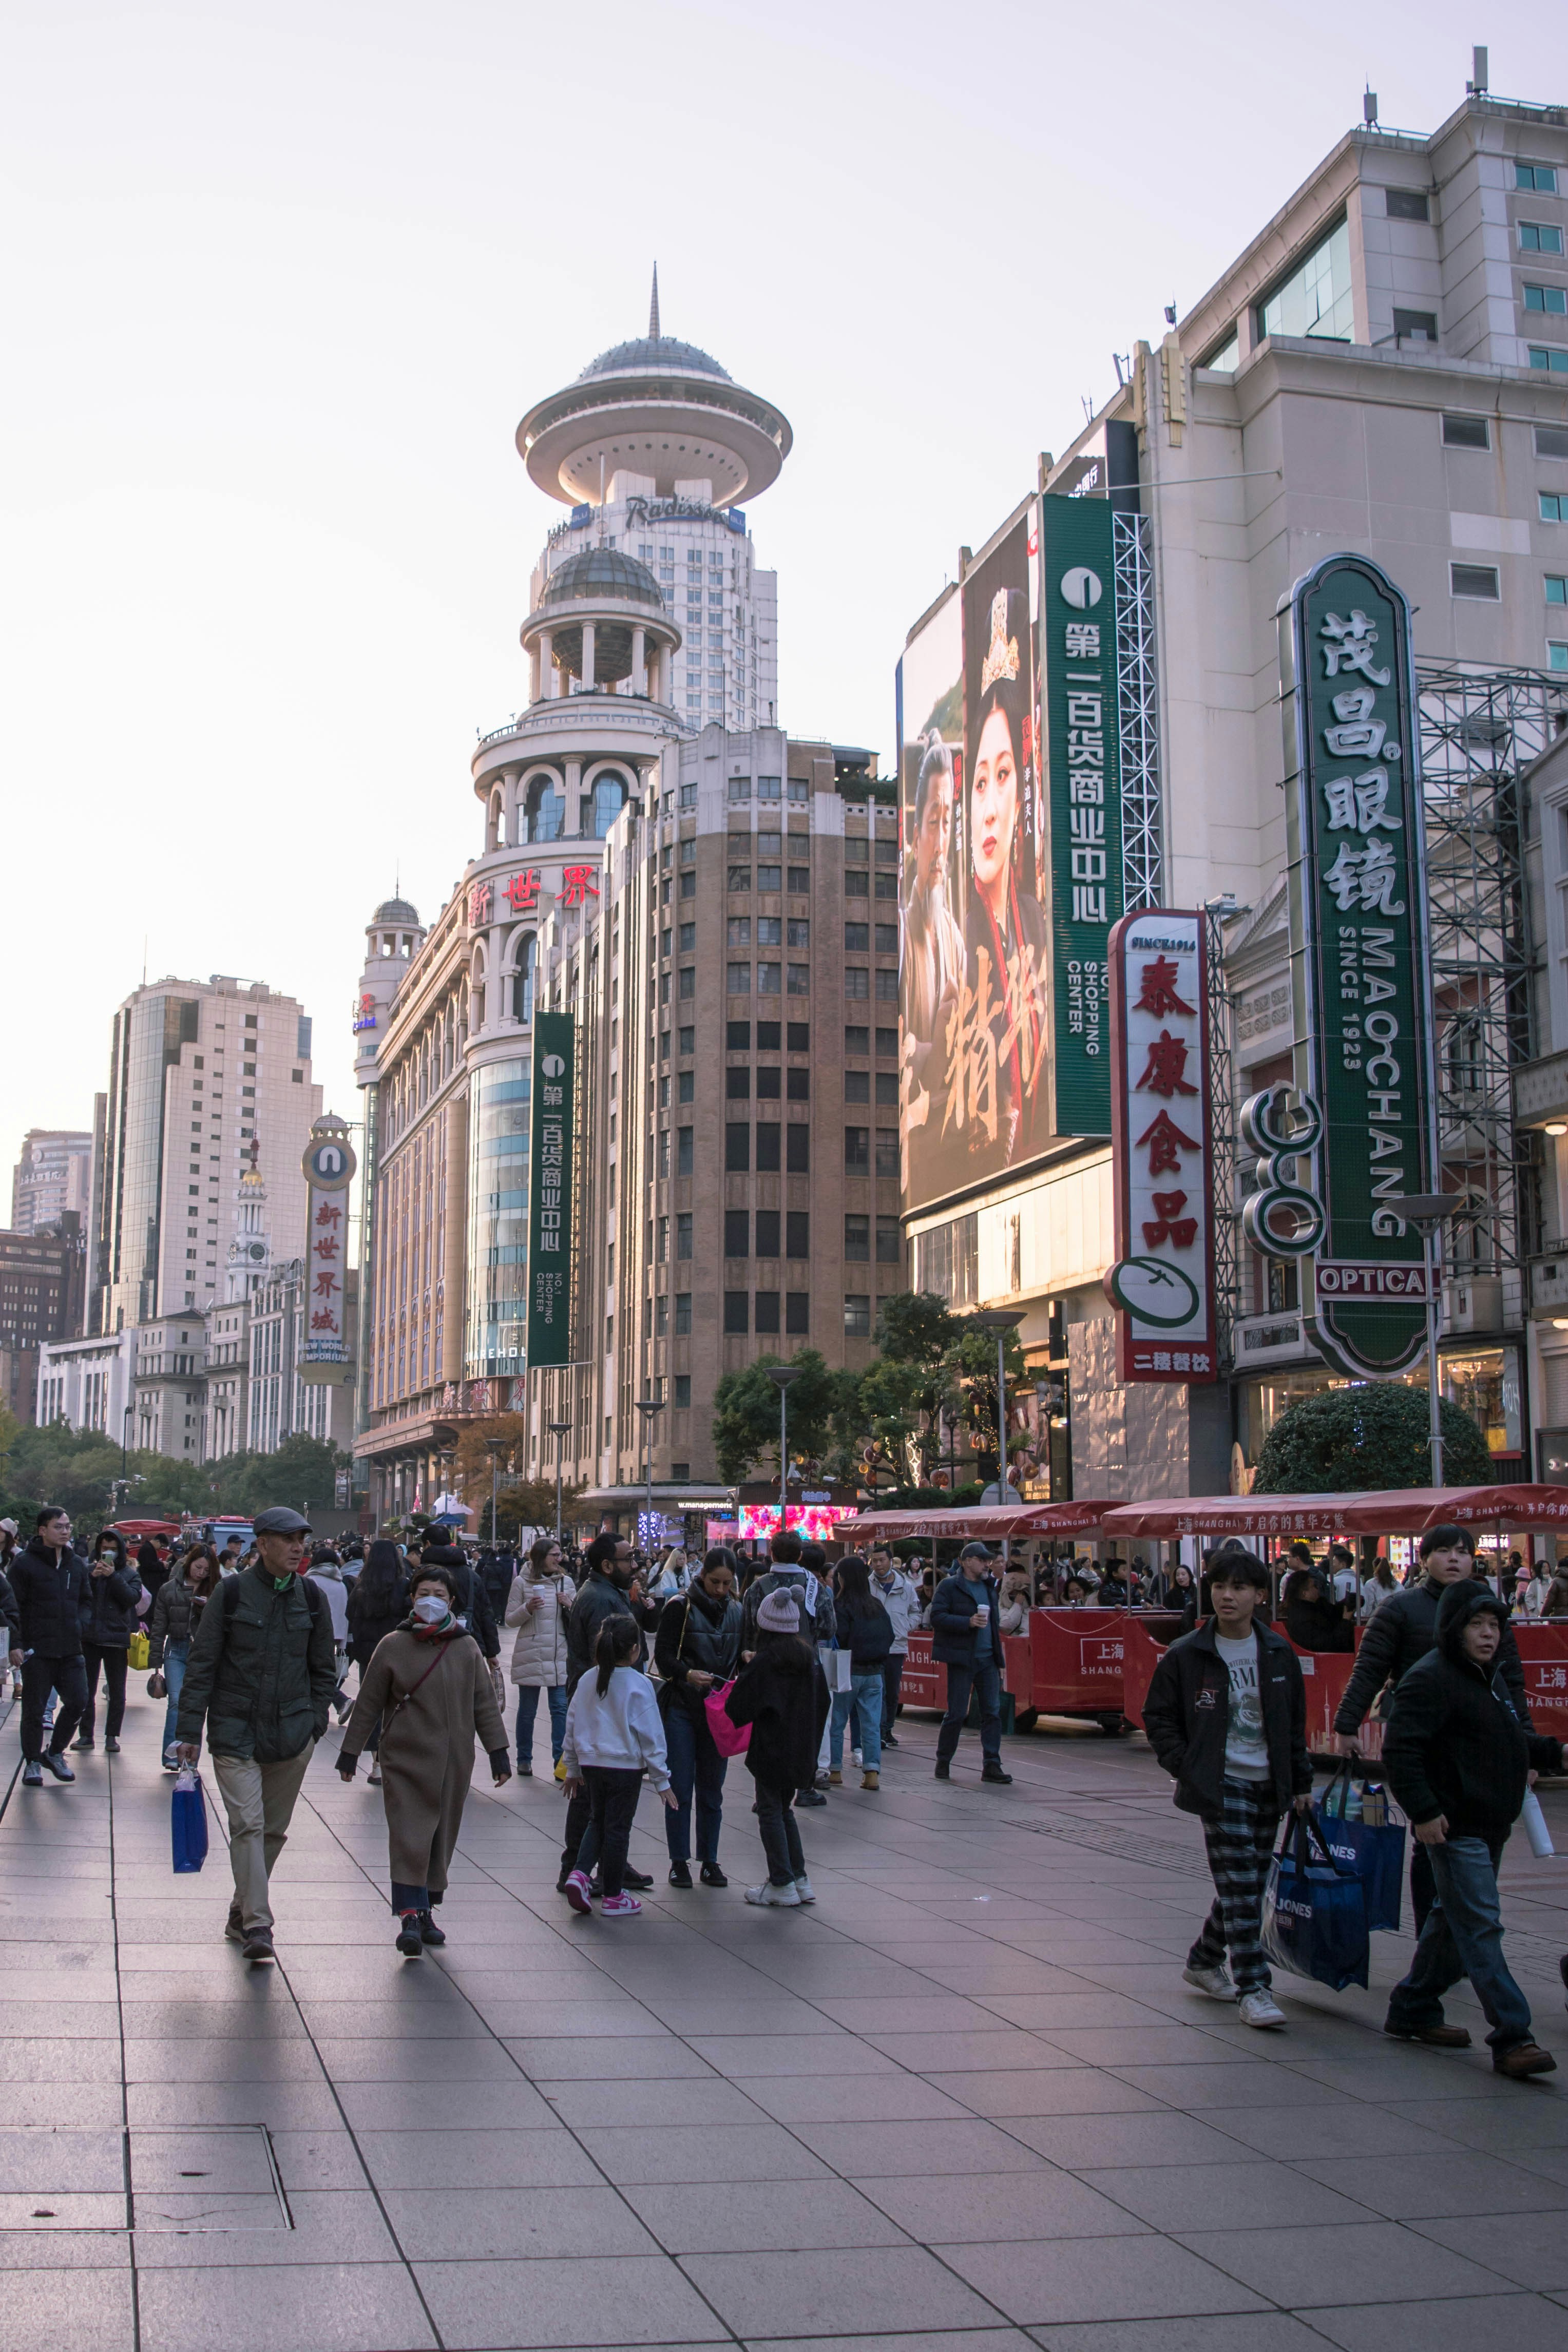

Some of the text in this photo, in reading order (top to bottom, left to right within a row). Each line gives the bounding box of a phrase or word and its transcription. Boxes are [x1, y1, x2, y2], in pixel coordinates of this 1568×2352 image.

[730, 514, 744, 526] BLU
[1065, 623, 1107, 923] 第一百货商业中心
[1320, 609, 1405, 915] 茂昌眼镜
[468, 866, 600, 925] 新世界
[1067, 960, 1083, 1034] CENTER
[1084, 961, 1099, 1056] SHOPPING
[1338, 927, 1362, 1070] SINCE 1923
[1361, 928, 1406, 1238] MAOCHANG
[1133, 954, 1201, 1249] 泰康食品
[540, 1086, 563, 1252] 第一百货商业中心
[311, 1201, 341, 1334] 新世界城
[1319, 1269, 1440, 1294] OPTICA
[536, 1273, 544, 1312] CENTER
[545, 1273, 553, 1324] SHOPPING
[299, 1353, 349, 1363] EMPORIUM
[321, 1342, 351, 1352] WORLD
[1134, 1352, 1210, 1372] 二楼餐饮
[1029, 1519, 1048, 1530] 上海
[1051, 1518, 1089, 1527] SHANGHAI
[1175, 1514, 1346, 1533] 上海 SHANGHAI 开启你的繁华之旅
[1452, 1507, 1473, 1520] 上海
[1097, 1643, 1123, 1660] 上海
[1081, 1666, 1122, 1675] SHANG
[1536, 1667, 1566, 1689] 上海
[1276, 1898, 1313, 1919] JONES
